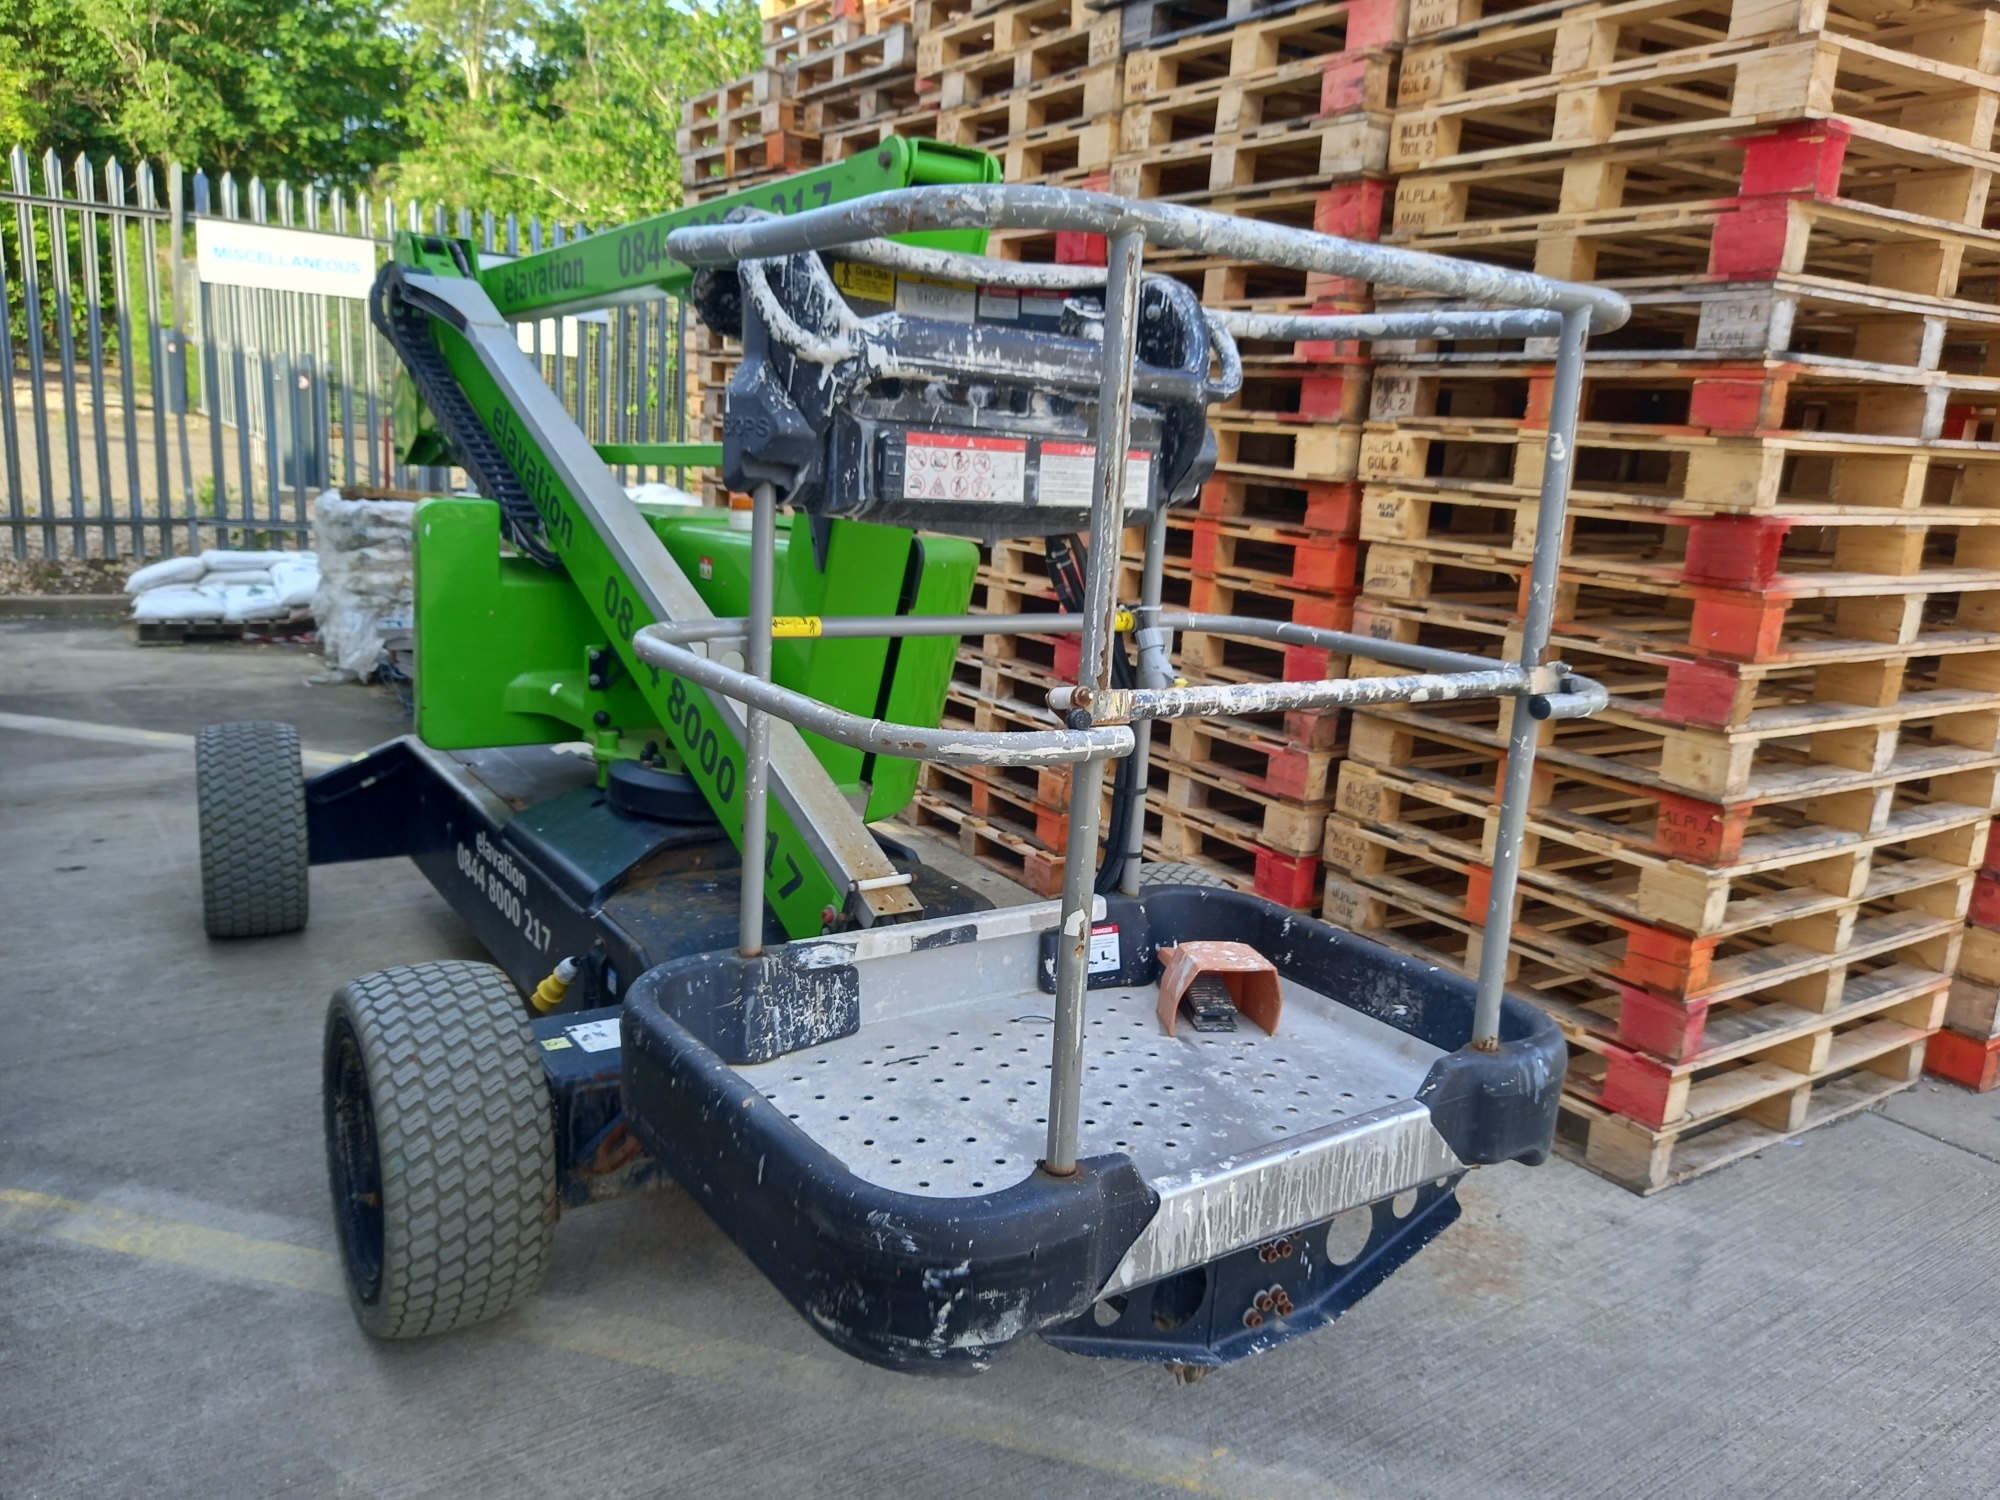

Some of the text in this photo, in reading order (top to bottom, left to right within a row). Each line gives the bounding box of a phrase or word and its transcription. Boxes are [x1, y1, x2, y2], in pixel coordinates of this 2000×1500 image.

[1402, 58, 1435, 77] ALPLA
[1401, 75, 1431, 95] GOL 2
[1400, 121, 1438, 138] ALPLA
[1400, 141, 1433, 156] GOL 2
[1398, 189, 1436, 203] ALPLA
[1400, 212, 1425, 225] MAN
[212, 246, 362, 274] MISCELLANEOUS
[504, 253, 584, 305] elavation
[1710, 331, 1744, 346] MAN
[1376, 397, 1407, 411] GOL 2
[1367, 441, 1403, 454] ALPLA
[1367, 457, 1398, 471] GOL 2
[493, 407, 573, 549] elavation
[1377, 503, 1400, 511] ALPLA
[1379, 511, 1396, 519] MAN
[668, 677, 735, 803] 8000
[742, 823, 804, 900] 17
[1346, 781, 1379, 802] ALPLA
[1367, 804, 1374, 816] 2
[1664, 810, 1713, 834] ALPLA
[1332, 832, 1366, 853] ALPLA
[1696, 836, 1706, 851] 2
[476, 831, 526, 896] elavation
[1333, 847, 1362, 866] GOL 2
[457, 842, 551, 955] 0844 8000 217
